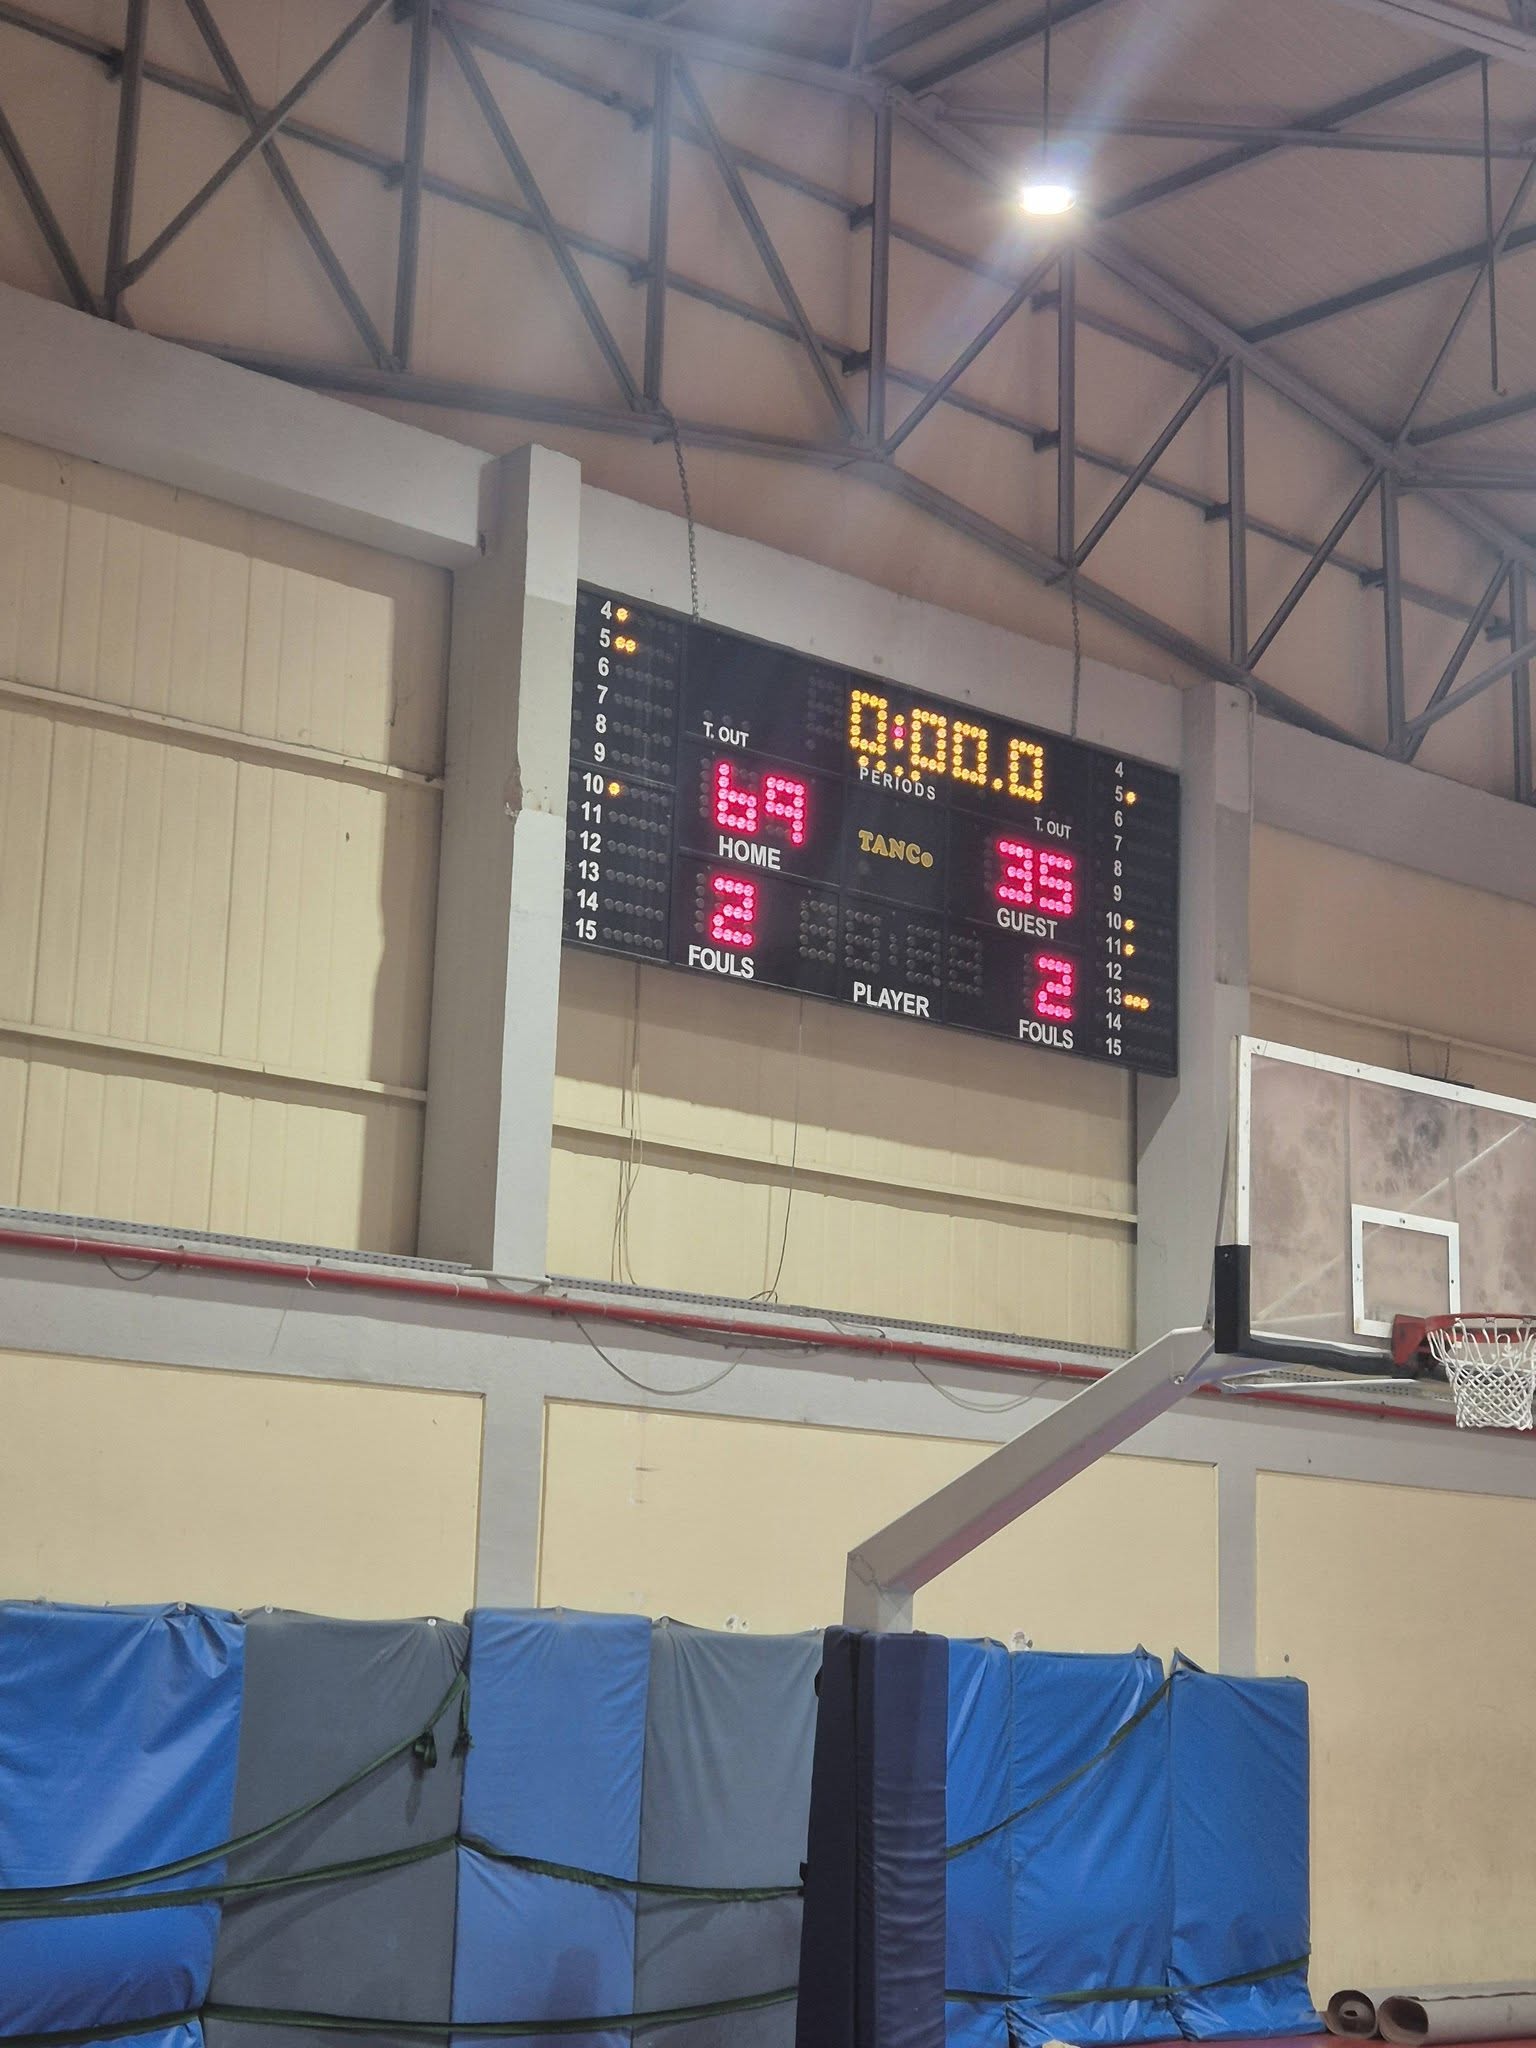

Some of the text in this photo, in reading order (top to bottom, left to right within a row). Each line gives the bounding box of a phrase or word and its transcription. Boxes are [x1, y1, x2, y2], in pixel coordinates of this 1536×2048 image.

[600, 601, 612, 620] 4
[599, 628, 611, 648] 5
[598, 657, 610, 677] 6
[596, 684, 609, 704] 7
[595, 713, 607, 733] 8
[718, 725, 749, 748] OUT
[593, 742, 606, 762] 9
[1115, 762, 1124, 777] 4
[582, 772, 604, 795] 10
[859, 767, 936, 800] PERIODS
[1114, 785, 1123, 802] 5
[581, 801, 602, 824] 11
[716, 761, 806, 844] 69
[1114, 810, 1123, 827] 6
[1047, 821, 1072, 839] OUT
[579, 830, 602, 854] 12
[1113, 835, 1122, 851] 7
[719, 835, 781, 870] HOME
[578, 860, 600, 882] 13
[998, 840, 1074, 915] 35
[1113, 860, 1122, 877] 8
[576, 888, 599, 911] 14
[1113, 885, 1122, 902] 9
[712, 877, 755, 946] 2
[1105, 911, 1122, 930] 10
[575, 917, 598, 941] 15
[996, 908, 1058, 940] GUEST
[1105, 936, 1122, 955] 11
[688, 944, 755, 979] FOULS
[1105, 962, 1122, 981] 12
[1037, 955, 1073, 1019] 2
[1105, 987, 1122, 1006] 13
[853, 981, 930, 1018] PLAYER
[1105, 1012, 1122, 1031] 14
[1018, 1018, 1074, 1050] FOULS
[1105, 1037, 1122, 1056] 15
